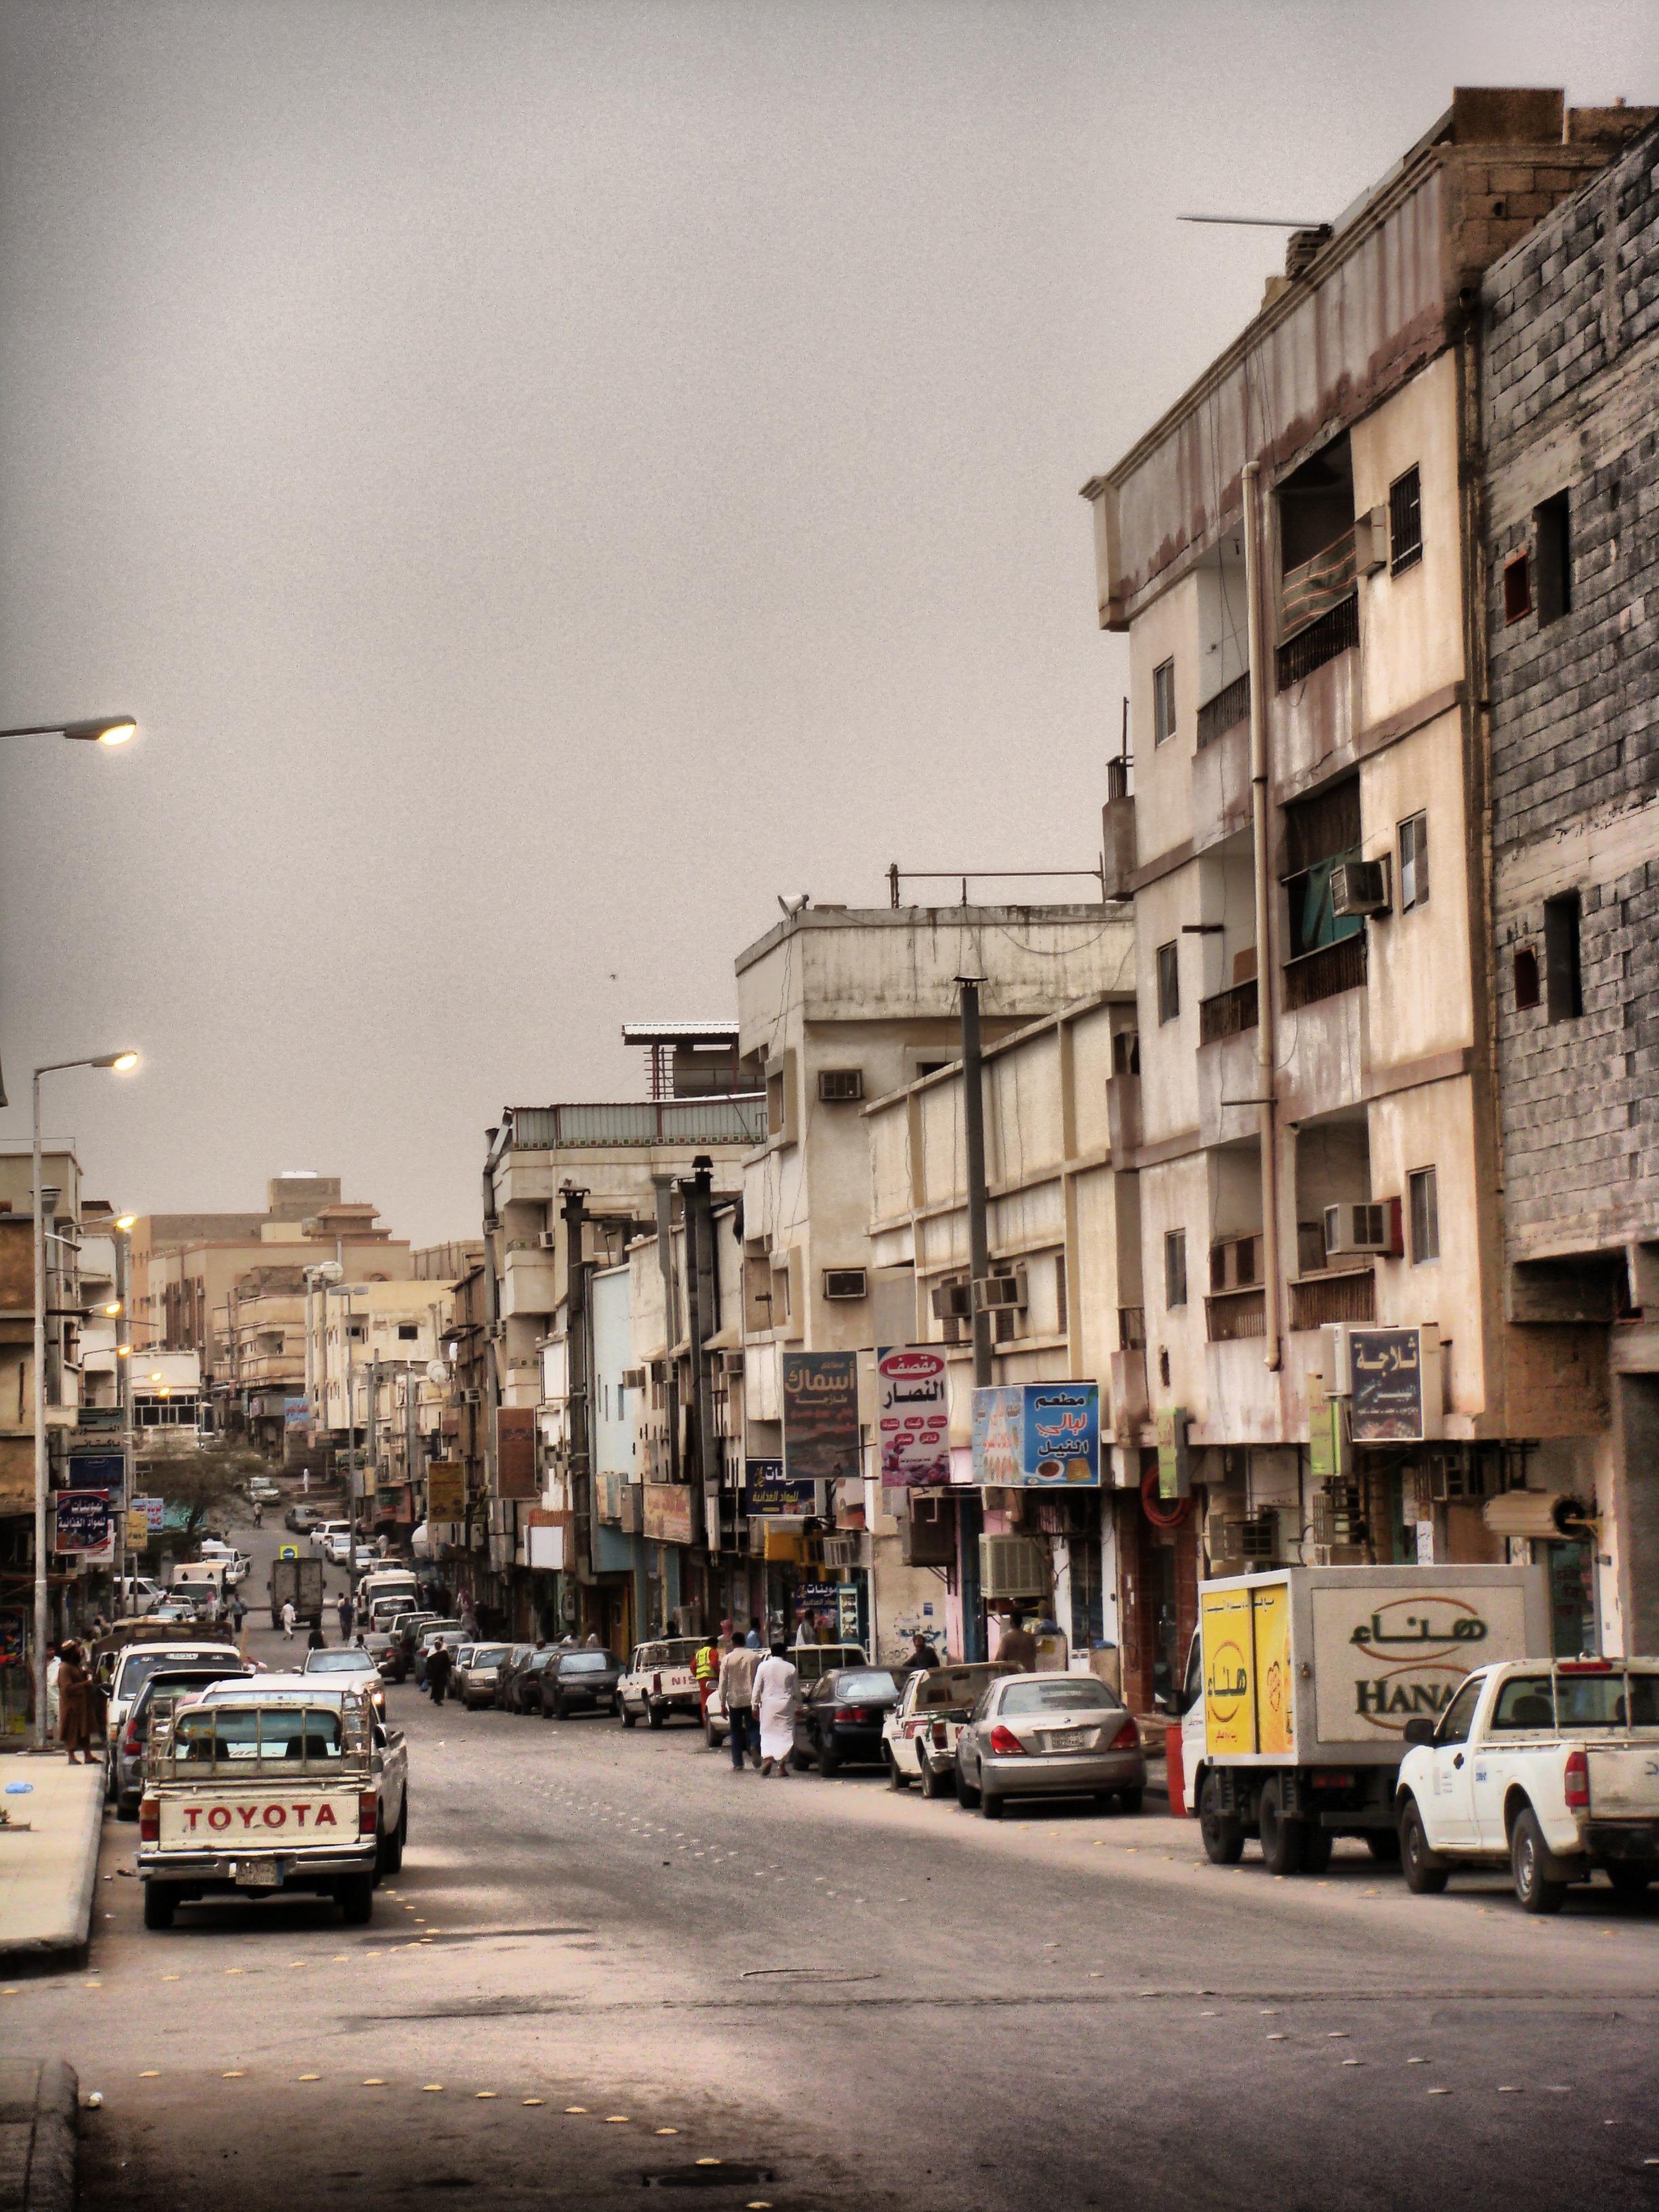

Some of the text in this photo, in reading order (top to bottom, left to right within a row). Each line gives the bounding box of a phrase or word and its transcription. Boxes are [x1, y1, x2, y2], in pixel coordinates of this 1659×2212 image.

[886, 1356, 937, 1375] مقصف
[1355, 1336, 1417, 1378] ثلاجة
[785, 1361, 855, 1393] أسماك
[883, 1379, 944, 1409] النصار
[1036, 1393, 1085, 1410] مطعم
[1036, 1413, 1087, 1437] ليالي
[1038, 1439, 1089, 1457] النيل
[1350, 1613, 1488, 1644] هناء
[1208, 1662, 1247, 1698] هناء
[184, 1803, 337, 1830] TOYOTA
